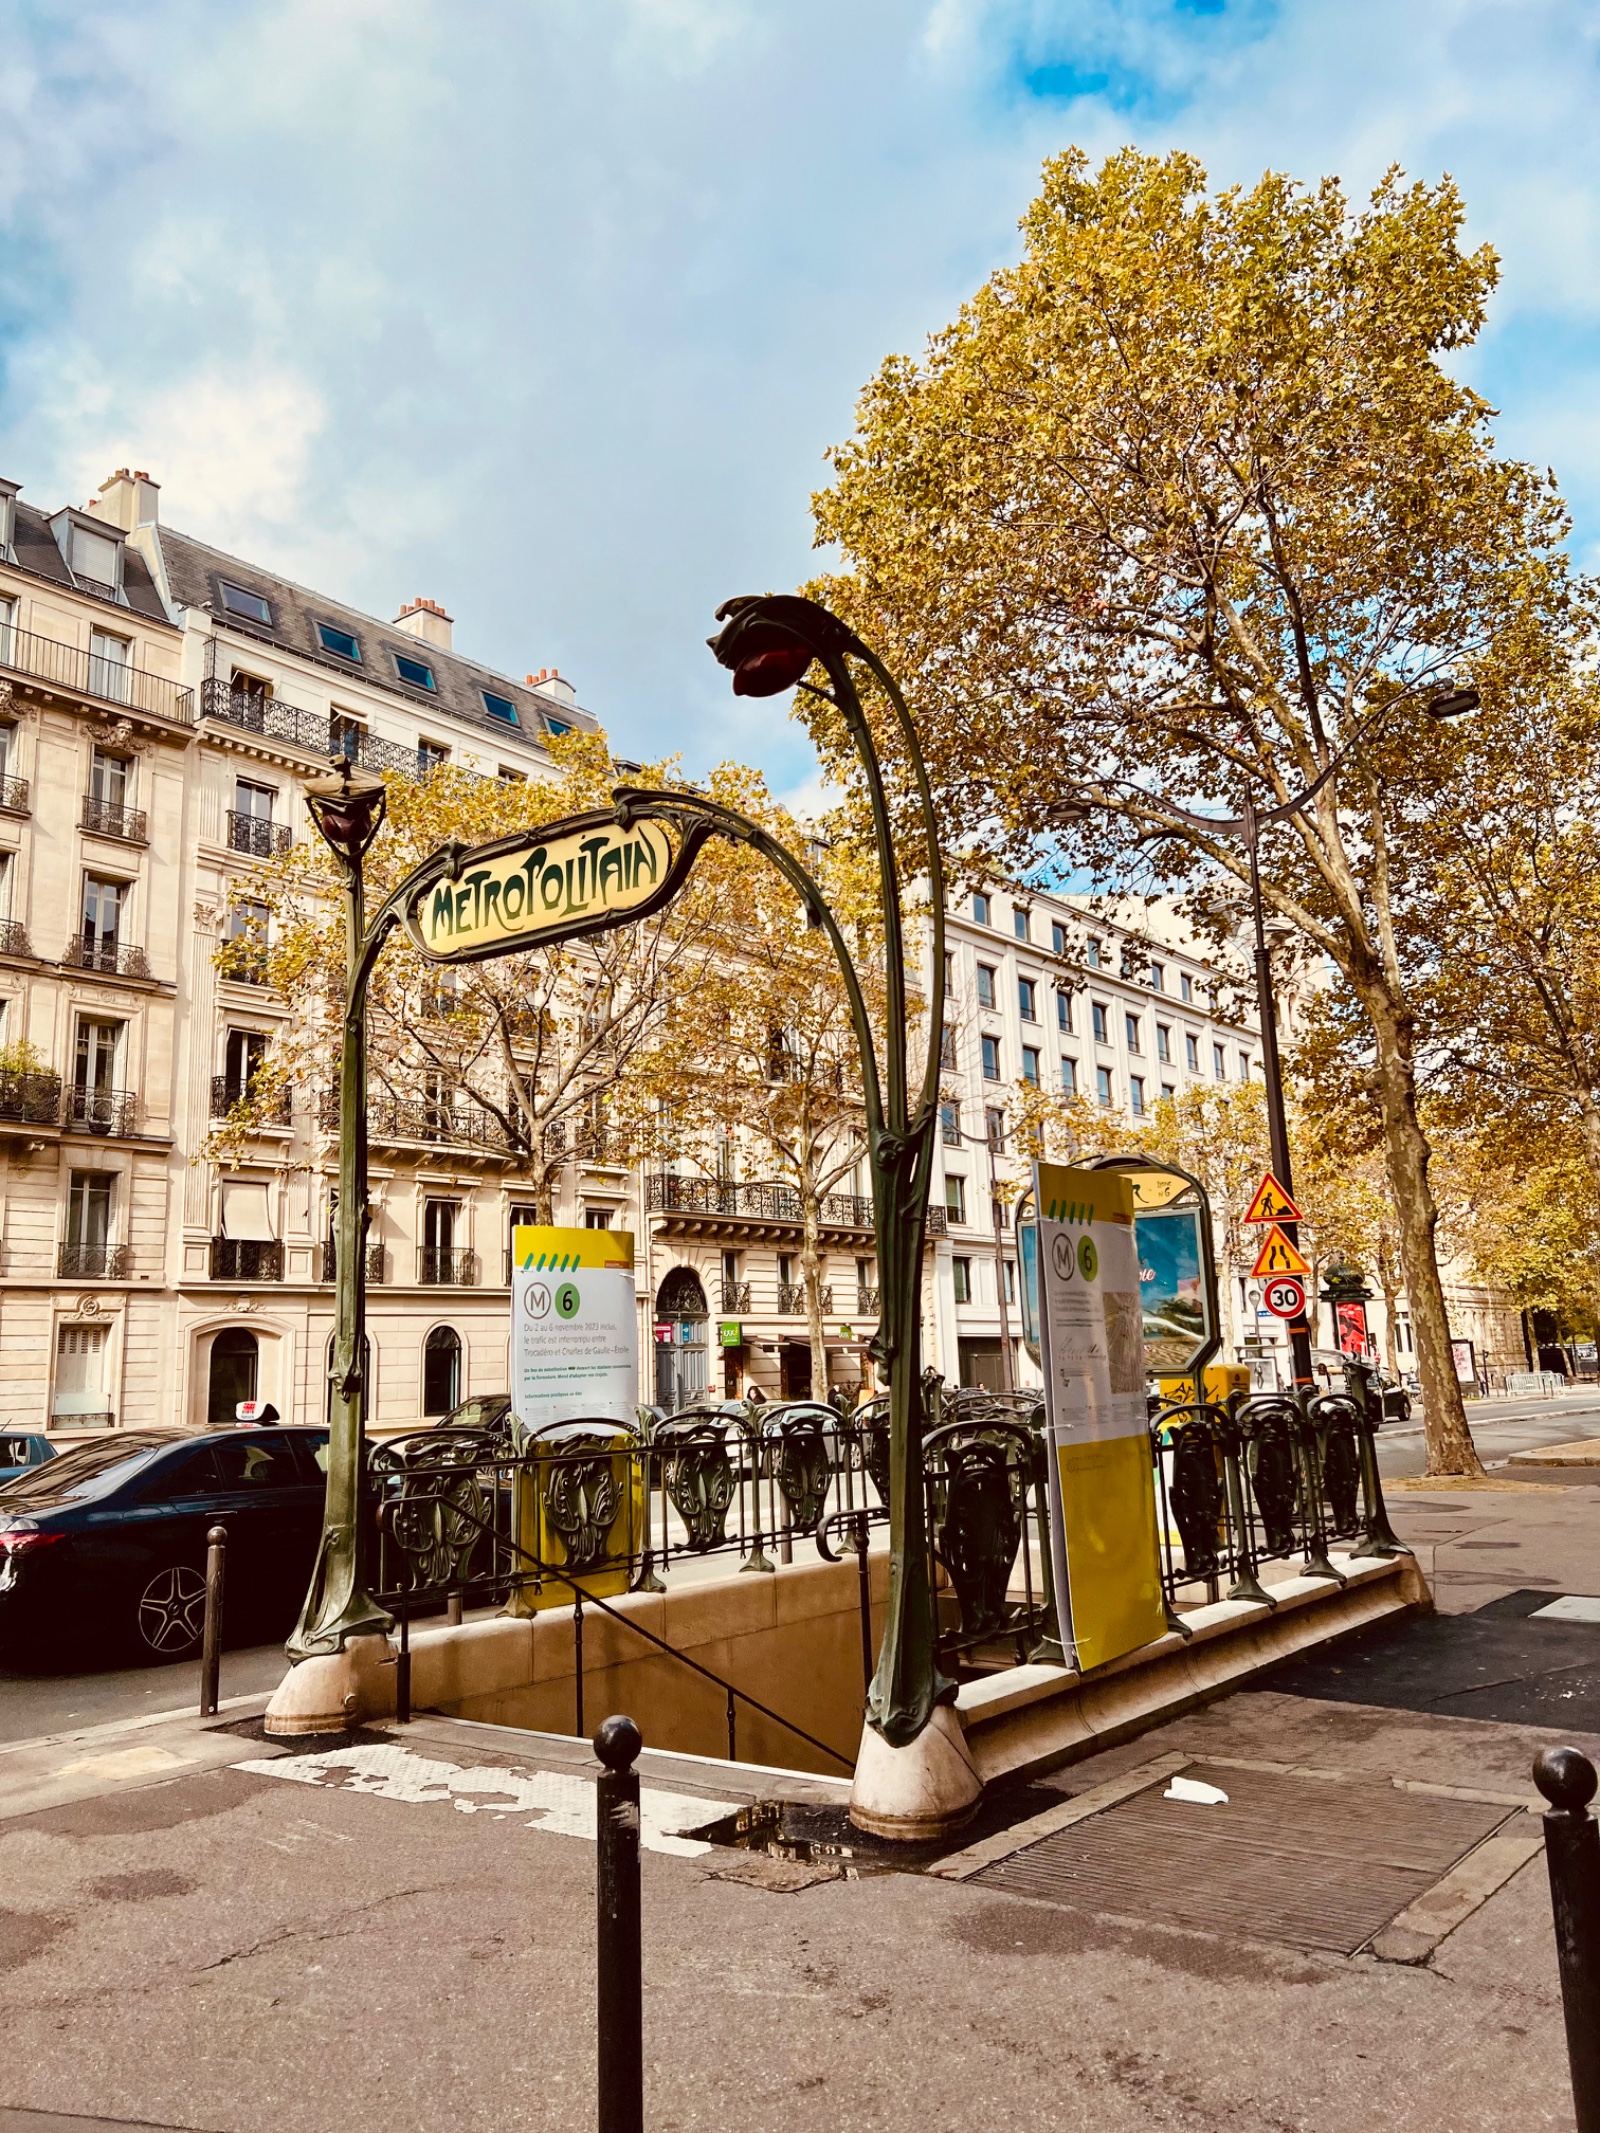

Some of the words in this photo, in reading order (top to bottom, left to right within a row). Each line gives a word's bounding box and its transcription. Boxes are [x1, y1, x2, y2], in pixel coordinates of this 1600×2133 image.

[430, 825, 657, 941] METROPOLITAIN
[1056, 1244, 1071, 1271] M
[1083, 1245, 1092, 1272] 6
[530, 1290, 545, 1311] M
[562, 1290, 573, 1312] 6
[1272, 1288, 1298, 1307] 30
[555, 1323, 583, 1331] novembre
